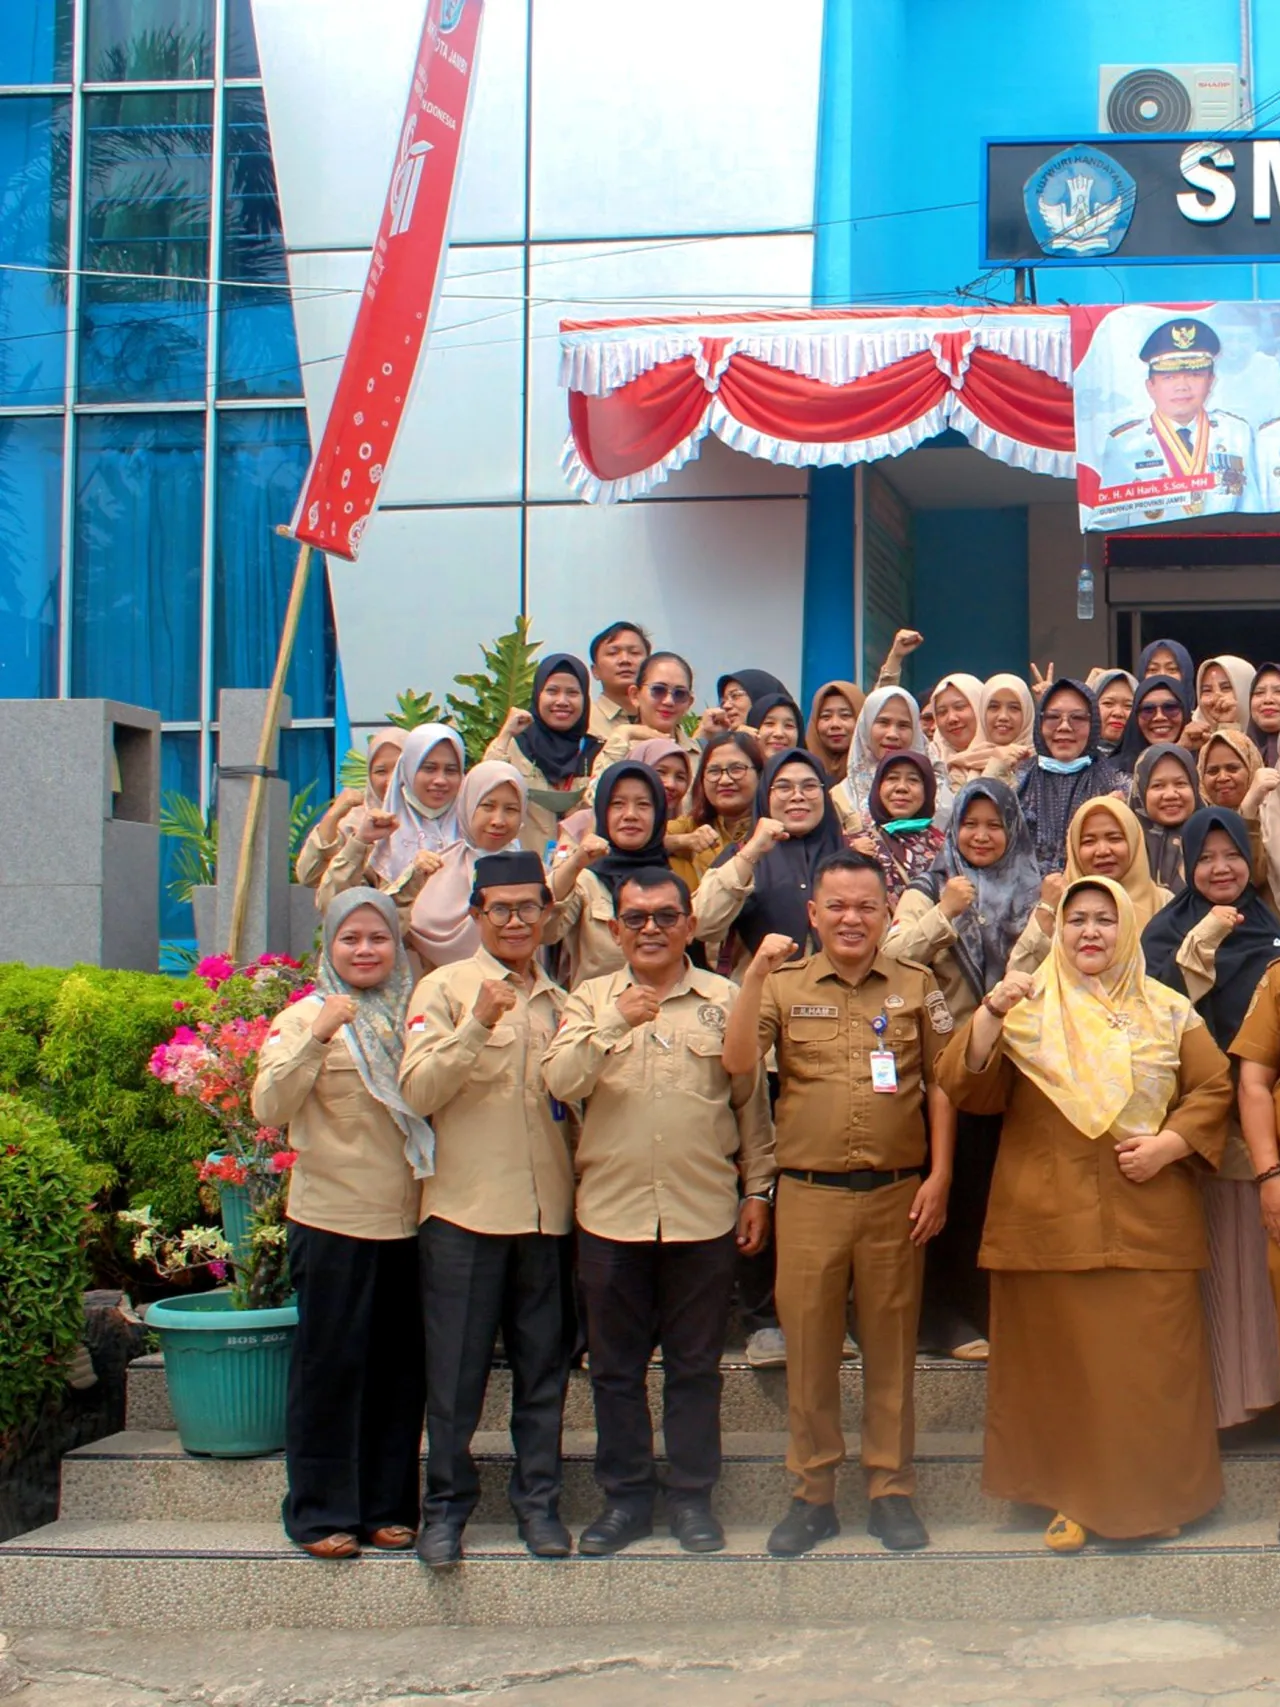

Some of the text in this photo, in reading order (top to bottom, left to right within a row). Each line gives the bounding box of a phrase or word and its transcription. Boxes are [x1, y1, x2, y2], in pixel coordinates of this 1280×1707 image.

[1098, 493, 1110, 501] Dr.
[1112, 491, 1122, 500] H.
[1191, 478, 1208, 488] MH
